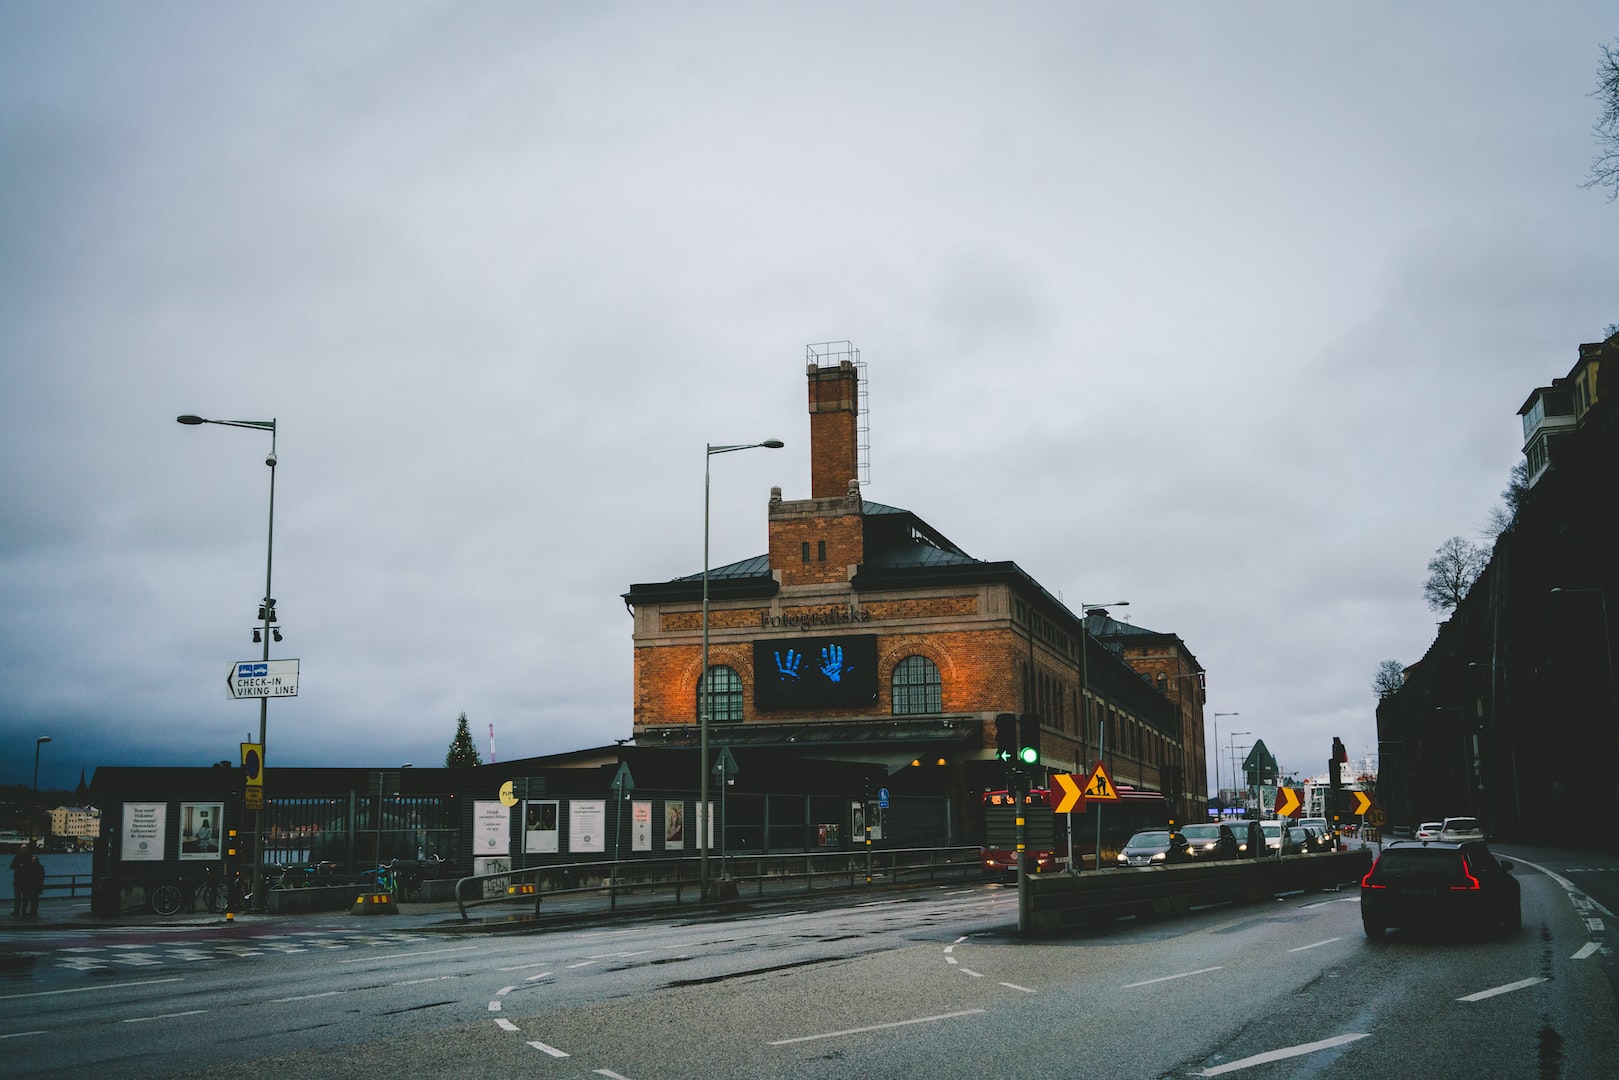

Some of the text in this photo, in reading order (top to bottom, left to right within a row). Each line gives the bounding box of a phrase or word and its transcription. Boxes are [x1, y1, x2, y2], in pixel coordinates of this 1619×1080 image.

[761, 605, 871, 631] Fotografiska
[237, 677, 281, 687] CHECK-IN
[237, 685, 295, 696] VIKING LINE
[1371, 812, 1385, 822] 30
